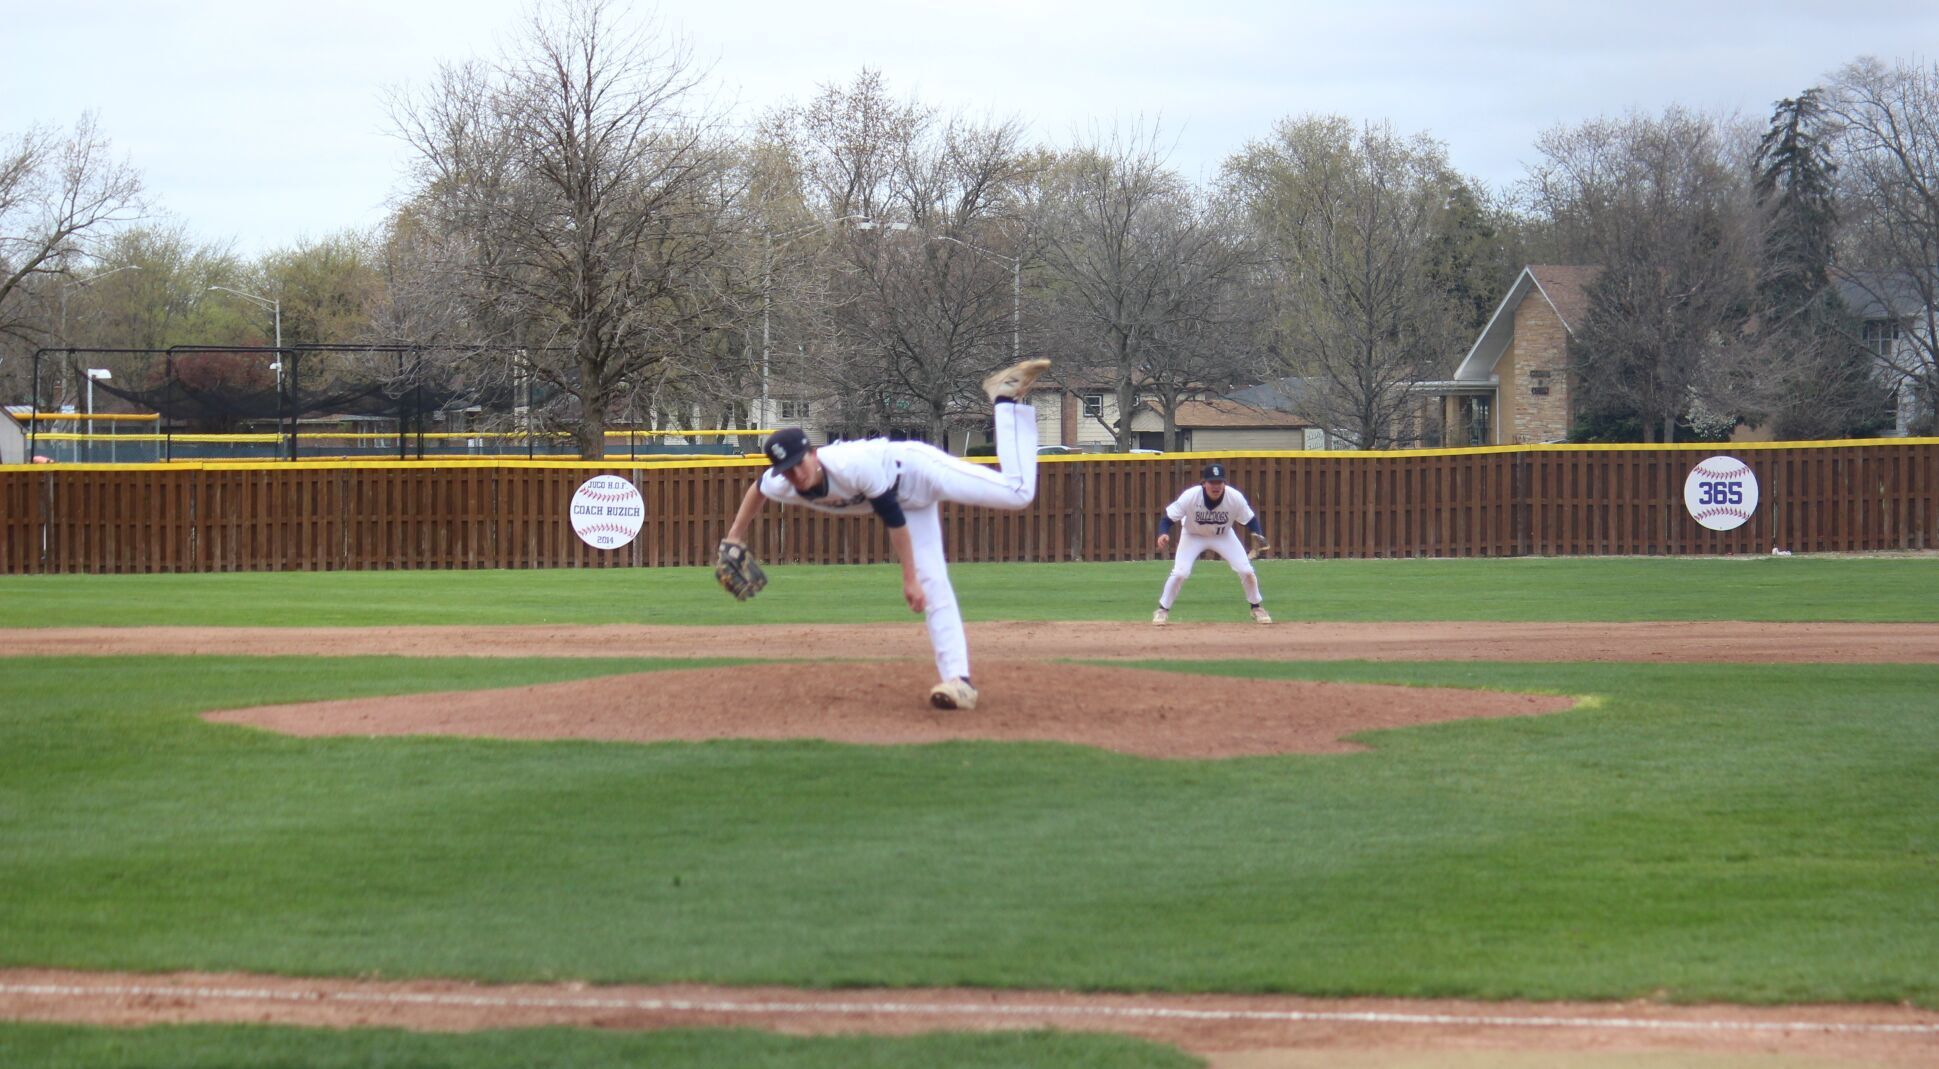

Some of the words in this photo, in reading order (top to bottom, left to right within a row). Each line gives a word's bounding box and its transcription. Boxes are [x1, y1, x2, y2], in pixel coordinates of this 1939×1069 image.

[588, 481, 606, 489] JUCO
[1699, 481, 1742, 505] 365
[573, 505, 603, 515] COACH
[607, 506, 640, 517] RUZICH
[1195, 511, 1229, 522] BULLDOGS
[1215, 526, 1226, 536] 11
[597, 535, 614, 544] 2014
